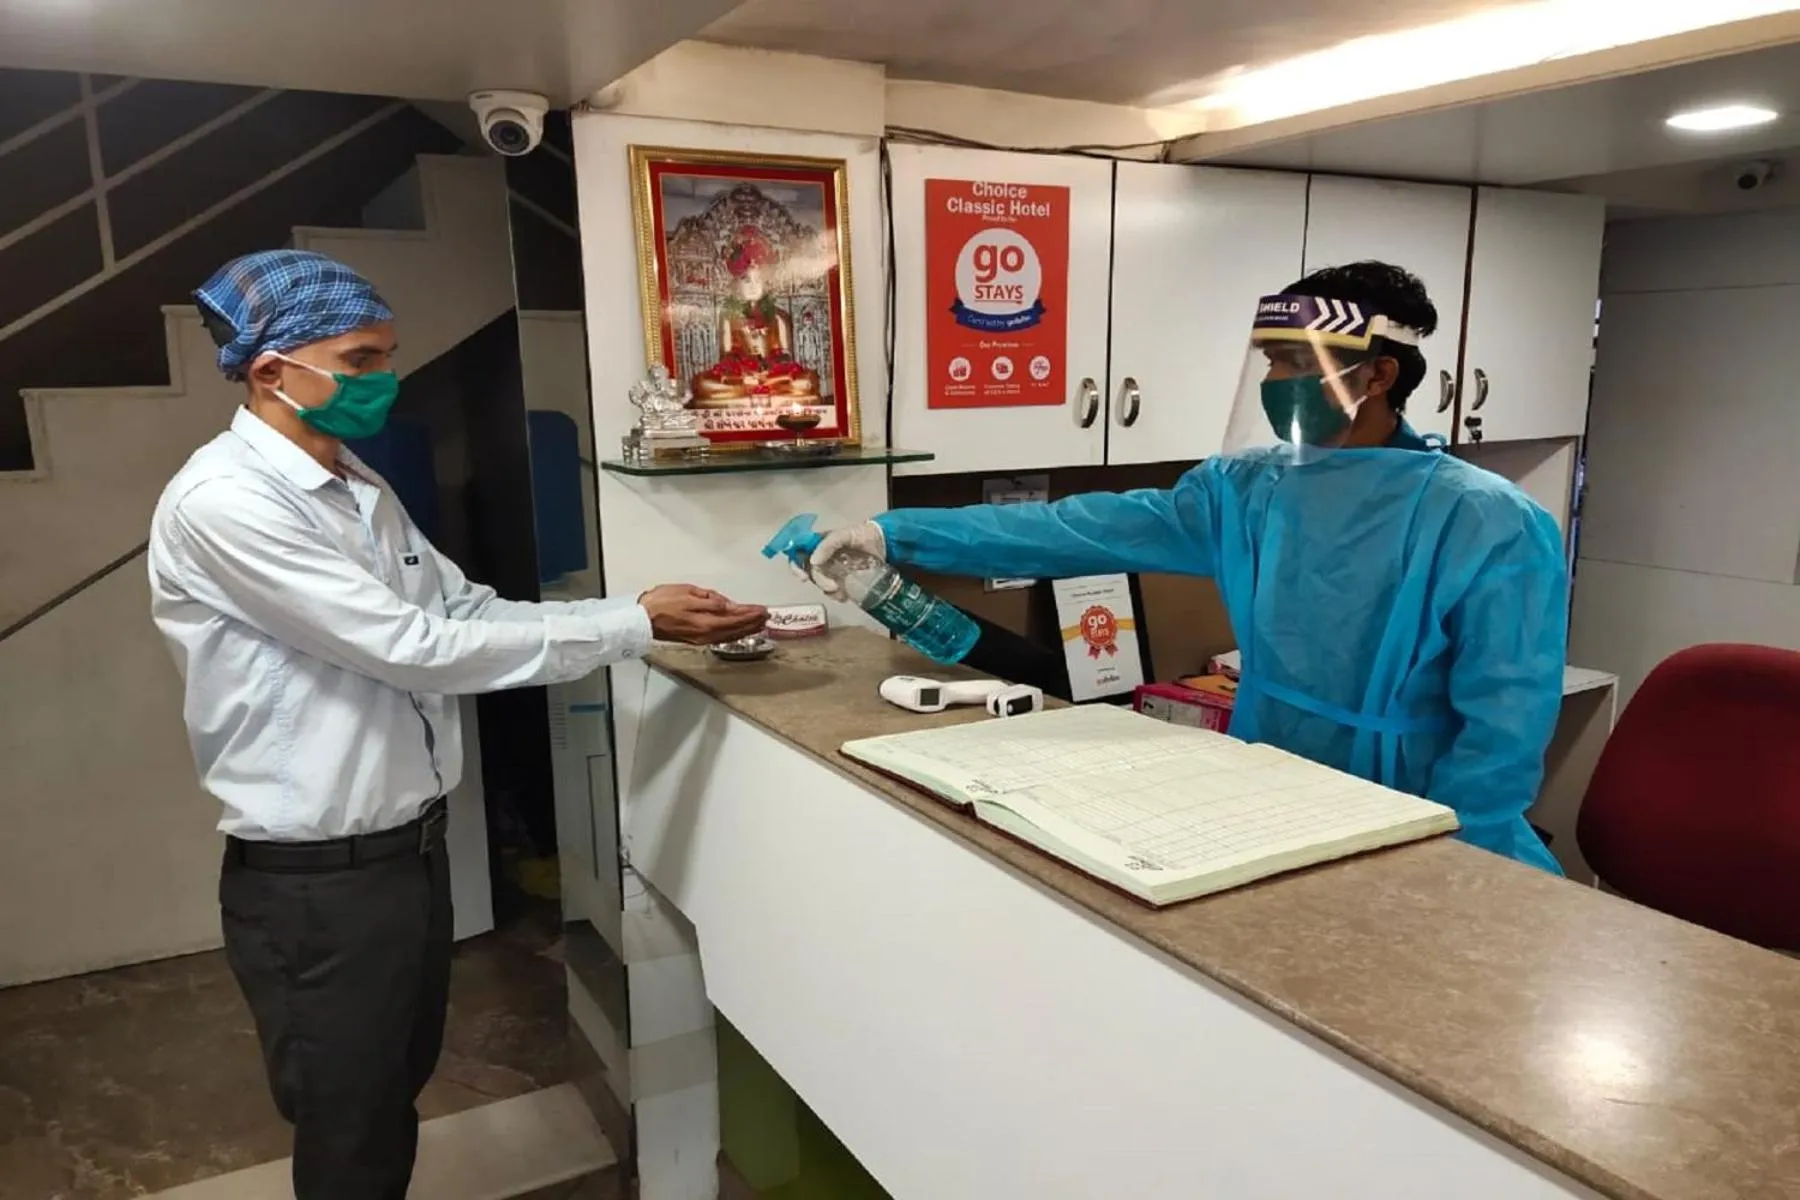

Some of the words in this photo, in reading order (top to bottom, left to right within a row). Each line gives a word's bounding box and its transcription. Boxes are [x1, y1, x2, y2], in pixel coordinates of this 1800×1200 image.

[972, 181, 1028, 199] Choice
[947, 197, 1006, 215] Classic
[1010, 199, 1050, 217] Hotel
[974, 244, 1025, 284] go
[975, 284, 1024, 300] STAYS
